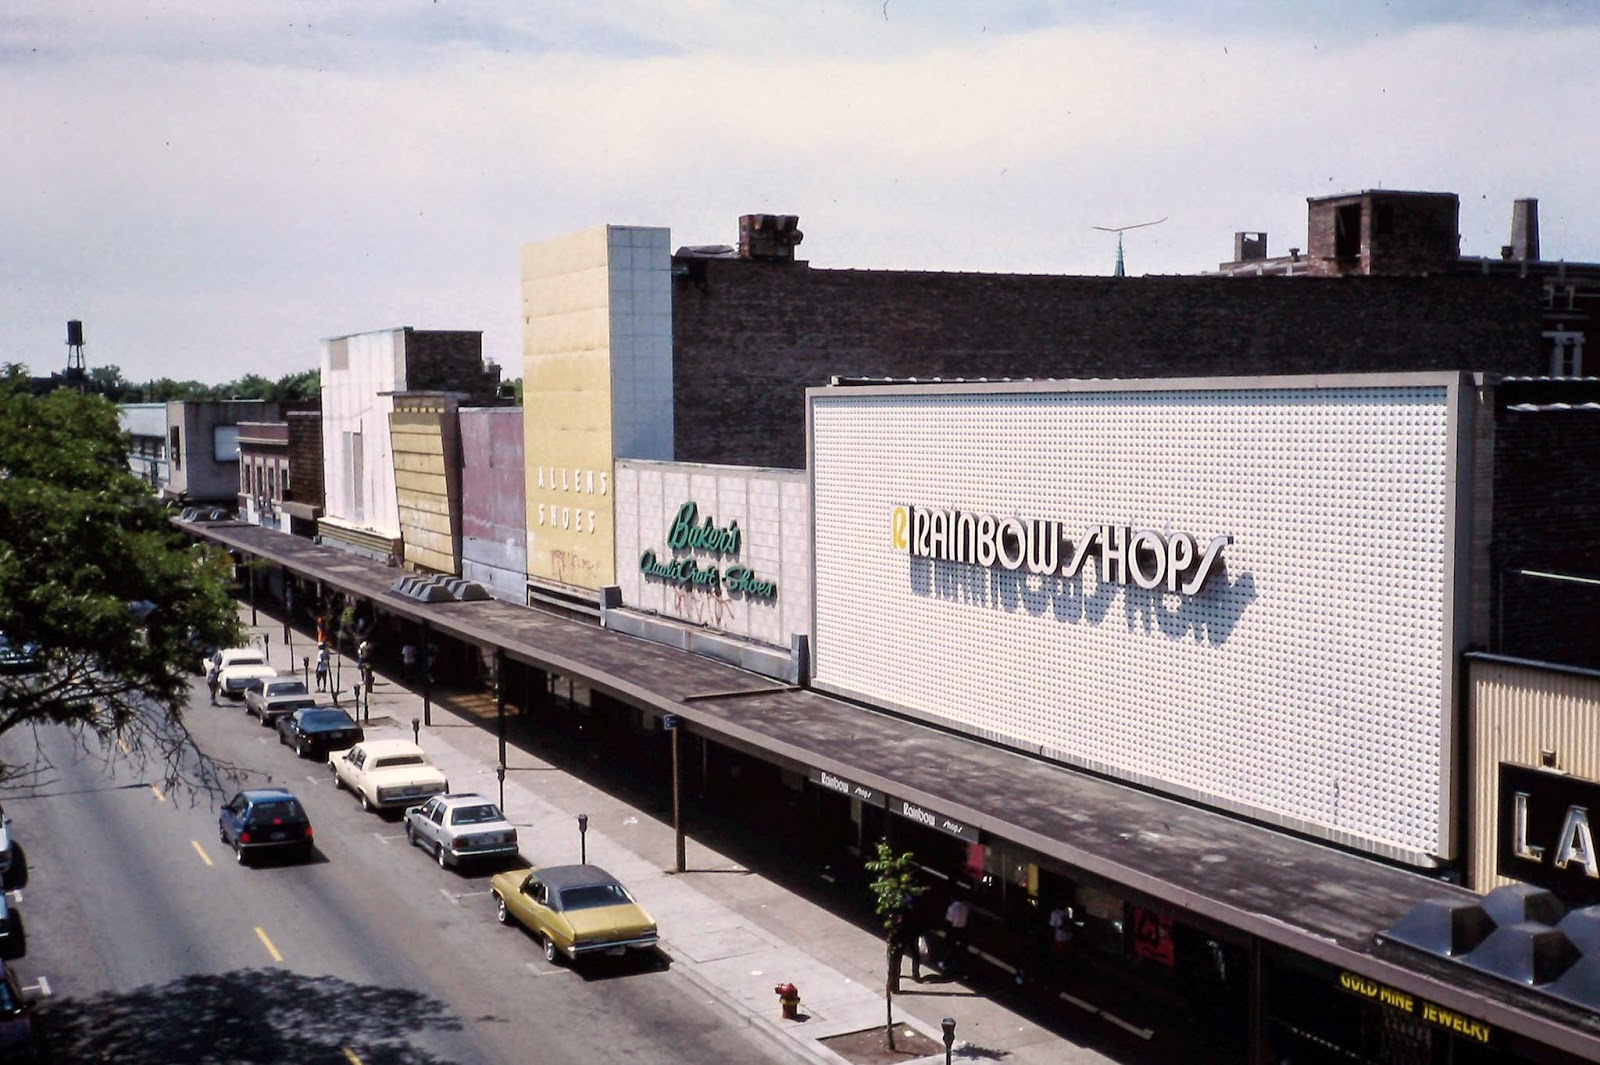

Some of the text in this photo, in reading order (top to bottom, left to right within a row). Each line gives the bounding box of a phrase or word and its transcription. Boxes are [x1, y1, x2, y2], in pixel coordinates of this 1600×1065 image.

[538, 467, 607, 496] ALLENS
[538, 503, 595, 535] SHOES
[667, 501, 741, 554] Baker's
[914, 508, 1062, 576] RAINBOW
[1062, 524, 1234, 596] SHOPS
[723, 565, 776, 598] Shoes
[821, 771, 849, 793] Rainbow
[903, 802, 936, 826] Rainbow
[1340, 971, 1491, 1043] GOLD MINE JEWELRY
